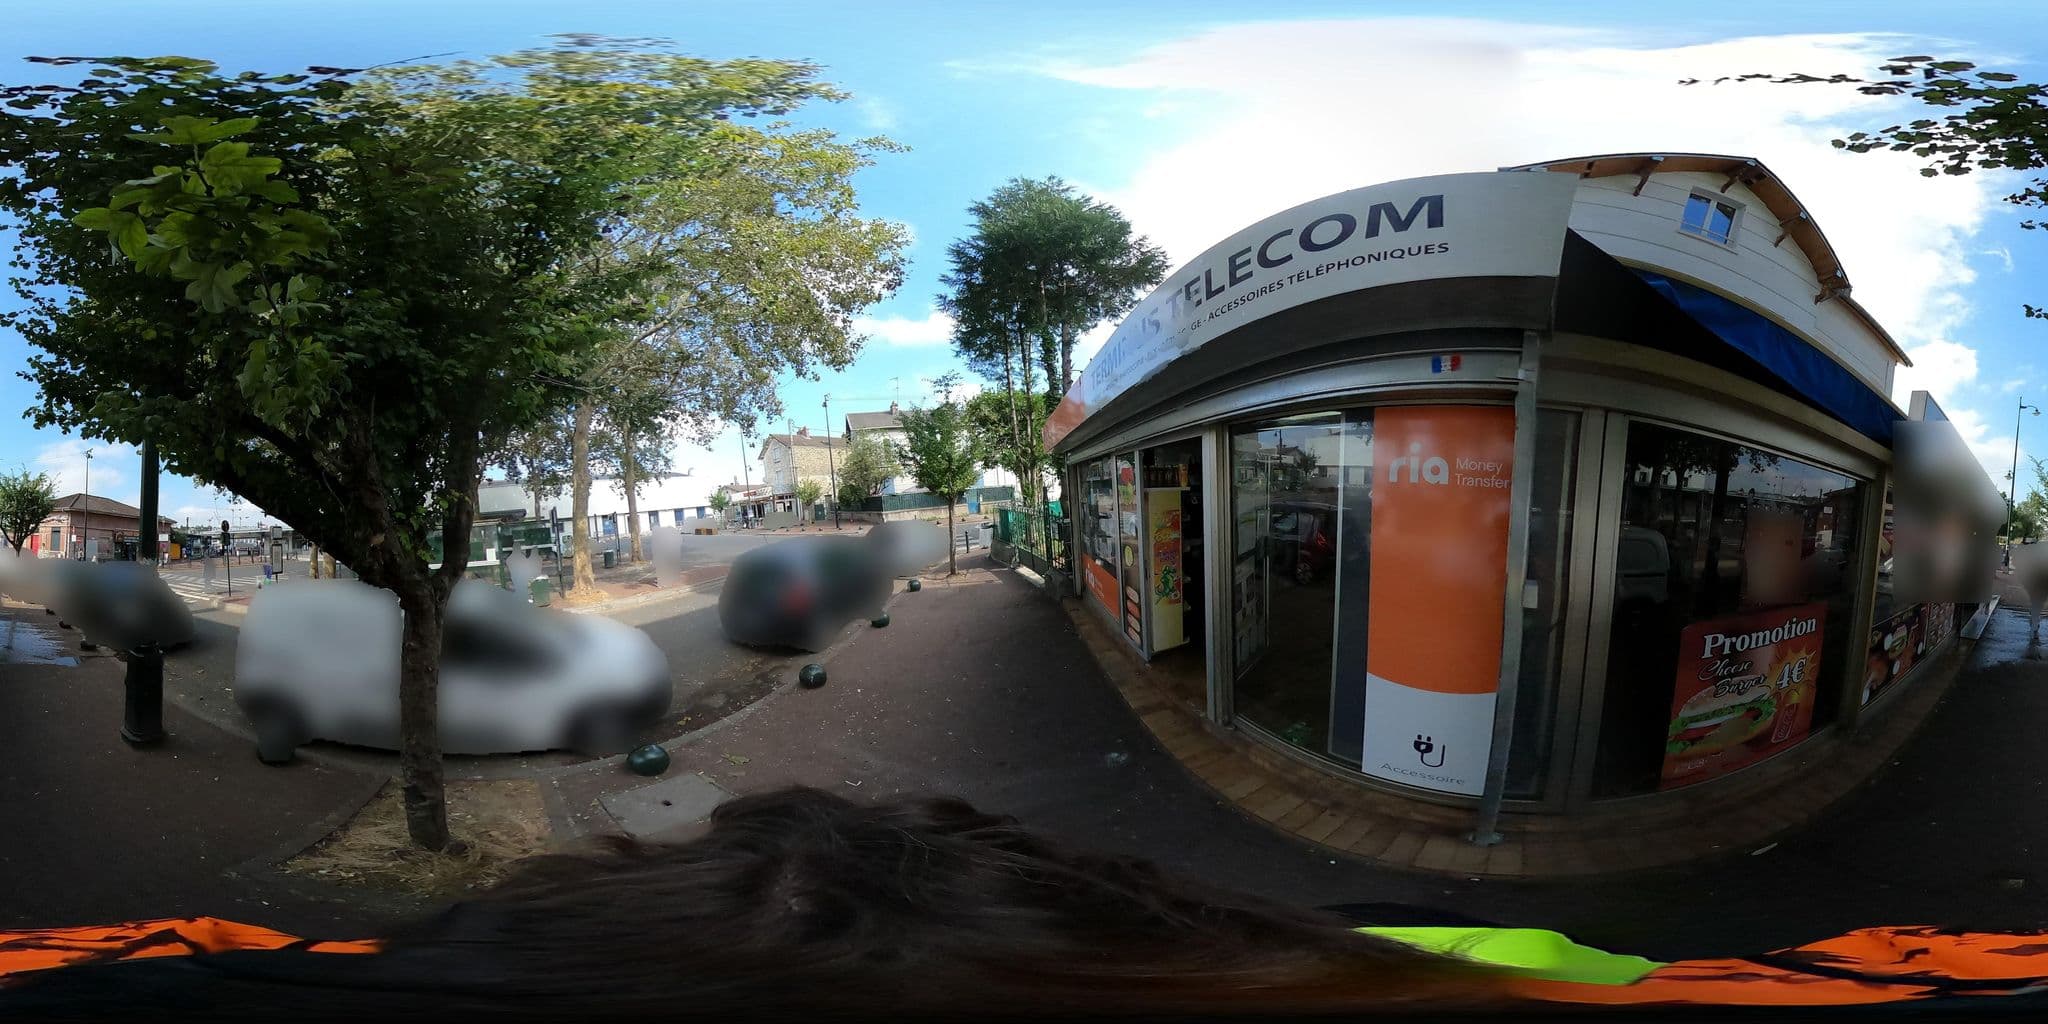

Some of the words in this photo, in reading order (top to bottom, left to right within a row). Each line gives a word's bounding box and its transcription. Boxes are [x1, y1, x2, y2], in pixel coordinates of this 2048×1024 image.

[1166, 194, 1444, 317] TELECOM
[1208, 279, 1284, 322] ACCESSOIRES
[1288, 241, 1449, 285] TÉLÉPHONIQUES
[1388, 440, 1449, 485] ria
[1455, 457, 1504, 475] Money
[1455, 473, 1510, 489] Transfer
[1701, 617, 1816, 658] Promotion
[1713, 674, 1768, 698] Burger
[1776, 658, 1807, 690] 4€
[1380, 762, 1465, 785] Accessoire
